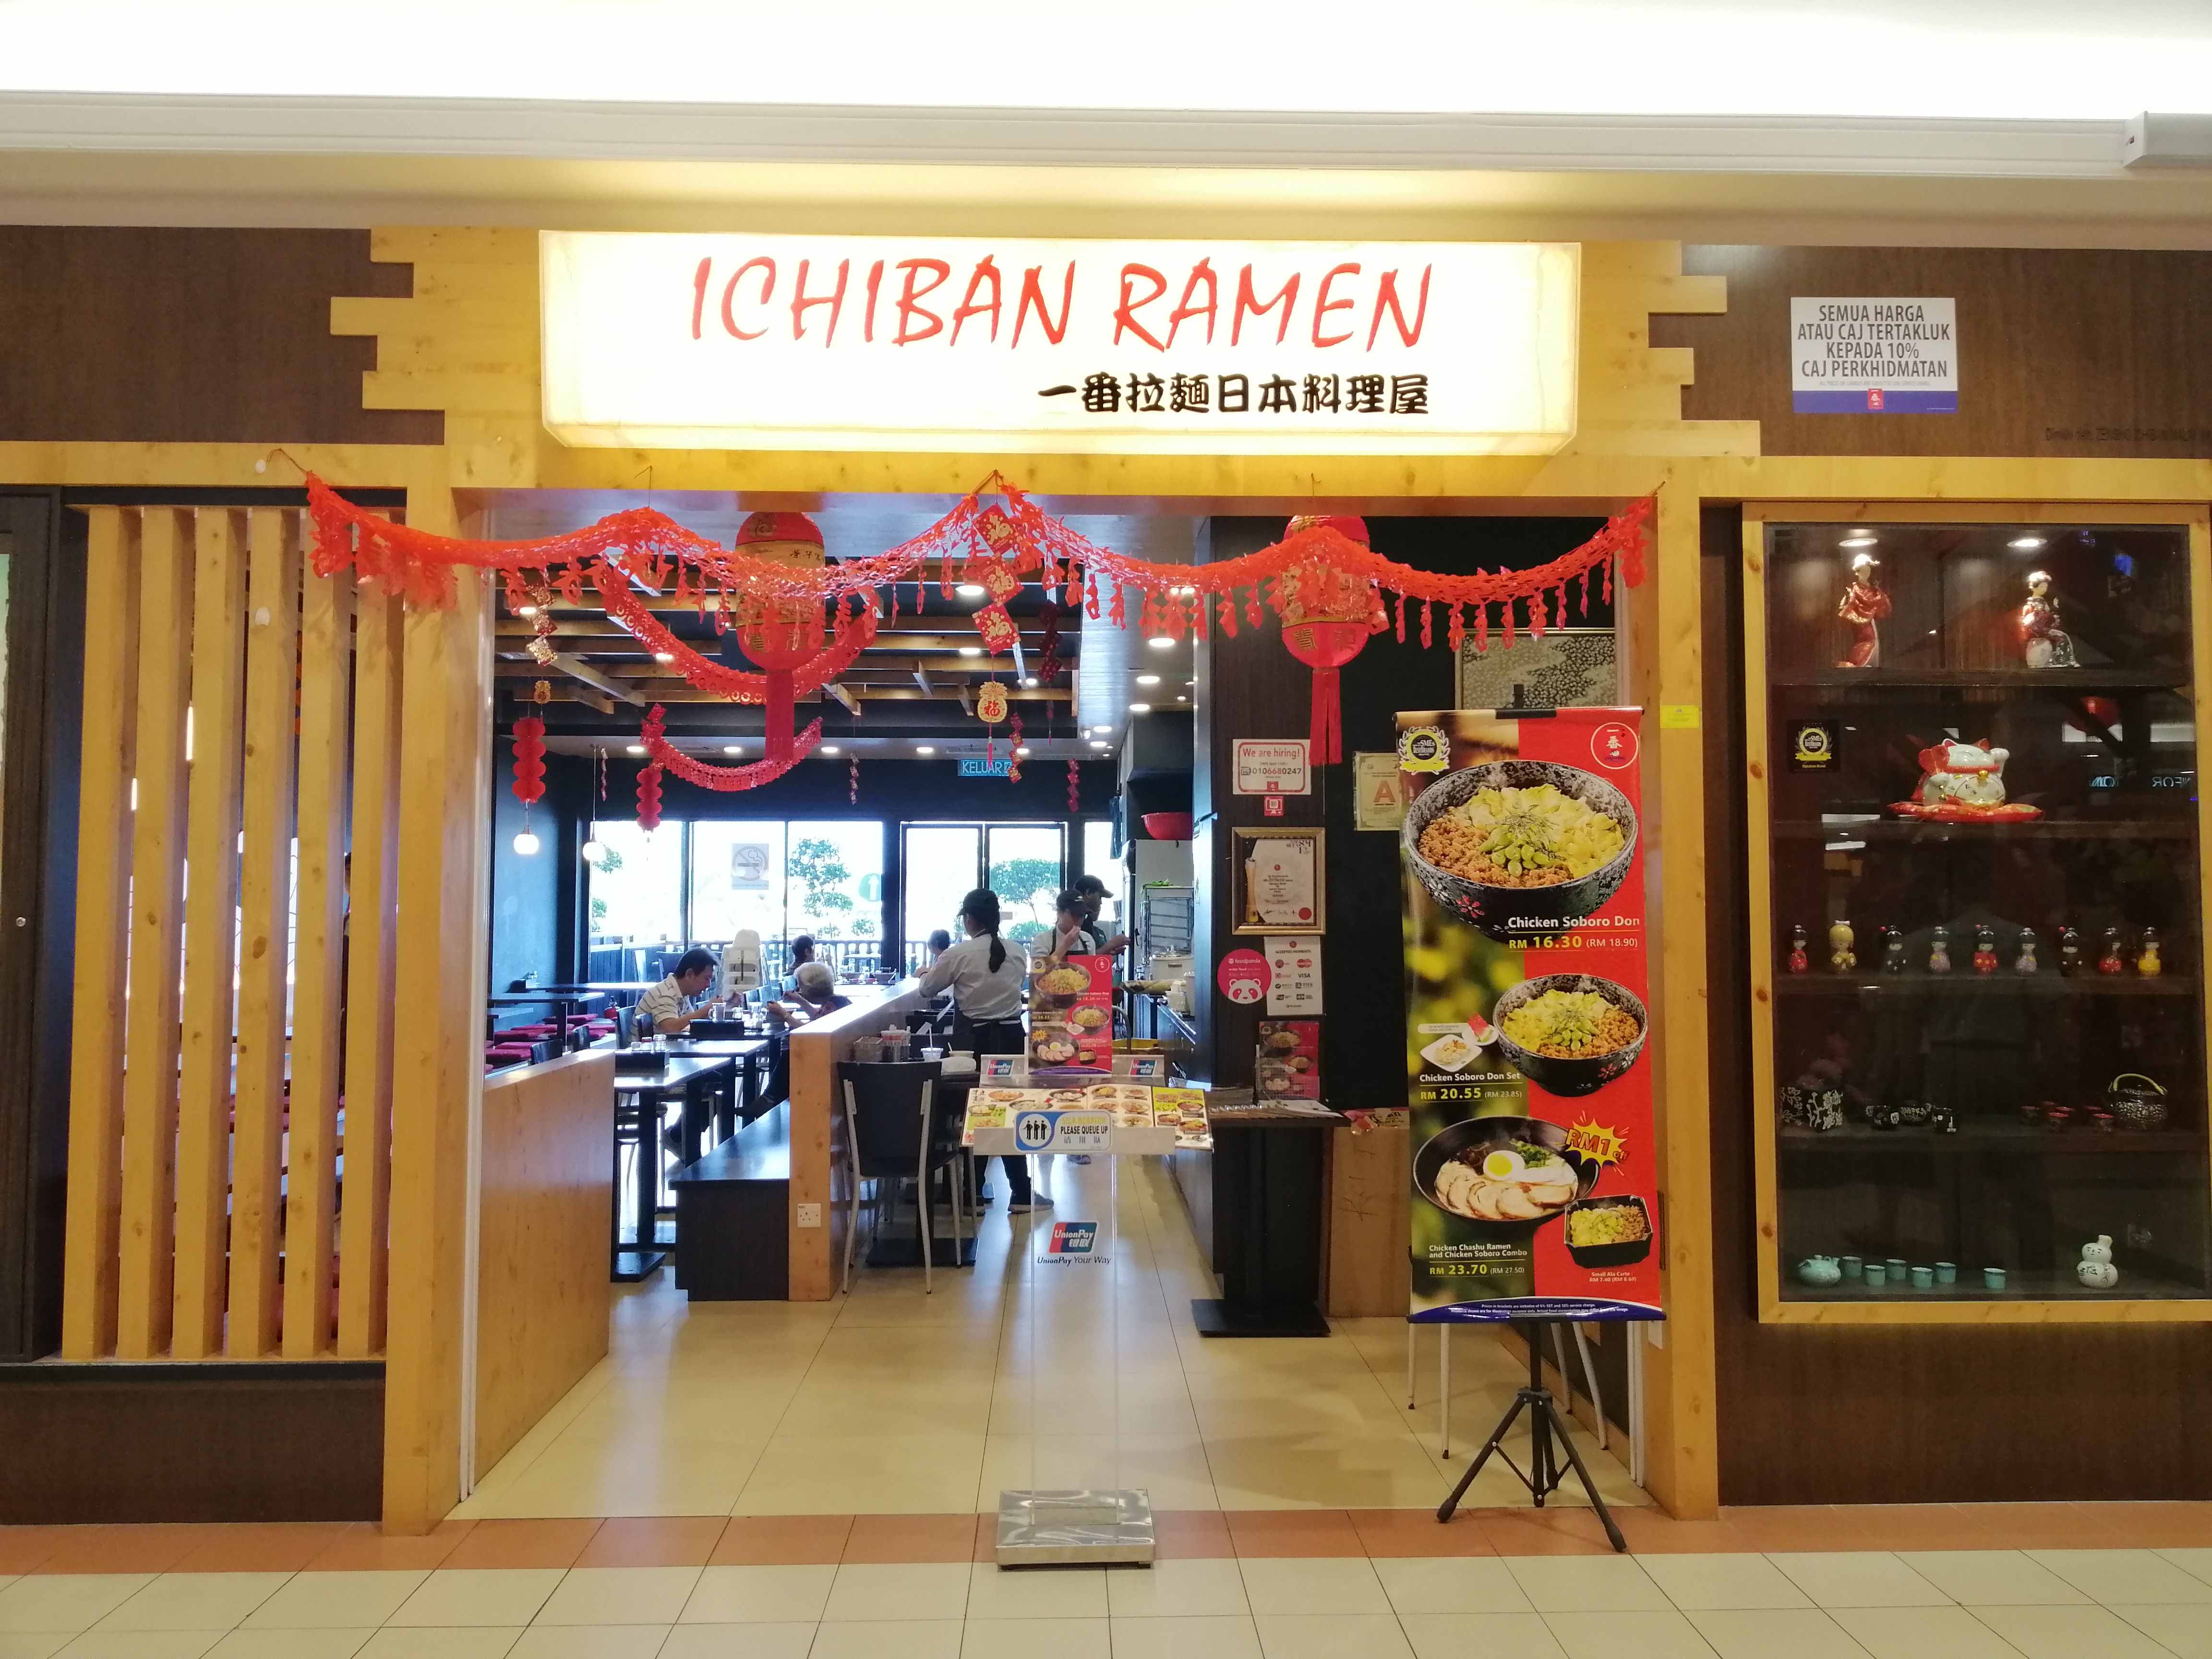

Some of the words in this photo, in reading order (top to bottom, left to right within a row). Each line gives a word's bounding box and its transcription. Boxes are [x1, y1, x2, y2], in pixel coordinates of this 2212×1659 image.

[692, 254, 1076, 349] ICHIBAN
[1114, 257, 1431, 352] RAMEN
[1819, 305, 1870, 322] SEMUA
[1874, 305, 1924, 322] HARGA
[1798, 324, 1833, 340] ATAU
[1838, 324, 1863, 340] CAJ
[1867, 324, 1950, 340] TERTAKLUK
[1827, 342, 1883, 359] KEPADA
[1887, 342, 1919, 359] 10%
[1802, 360, 1827, 377] CAJ
[1832, 360, 1947, 377] PERKHIDMATAN
[1037, 371, 1429, 414] 一番拉麵日本料理屋
[1243, 747, 1256, 757] We
[1274, 747, 1299, 759] hiring!
[962, 761, 1002, 773] KELUAR
[1373, 780, 1396, 803] A
[1508, 916, 1559, 928] Chicken
[1563, 915, 1610, 927] Soboro
[1614, 915, 1640, 926] Don
[1509, 939, 1527, 949] RM
[1533, 936, 1582, 949] 16.30
[1586, 938, 1605, 949] (RM
[1610, 938, 1638, 948] 18.90)
[1419, 1074, 1453, 1082] Chicken
[1455, 1073, 1485, 1081] Soboro
[1420, 1091, 1436, 1100] RM
[1441, 1087, 1481, 1099] 20.55
[1501, 1090, 1522, 1098] 23.85)
[1060, 1126, 1080, 1134] PLEASE
[1082, 1126, 1099, 1134] QUEUE
[1101, 1125, 1108, 1134] UP
[1565, 1128, 1611, 1156] RM1
[1612, 1150, 1630, 1161] off
[1054, 1229, 1094, 1240] UnionPay
[1037, 1256, 1072, 1266] UnionPay
[1094, 1256, 1111, 1265] Way
[1448, 1264, 1487, 1275] 23.70
